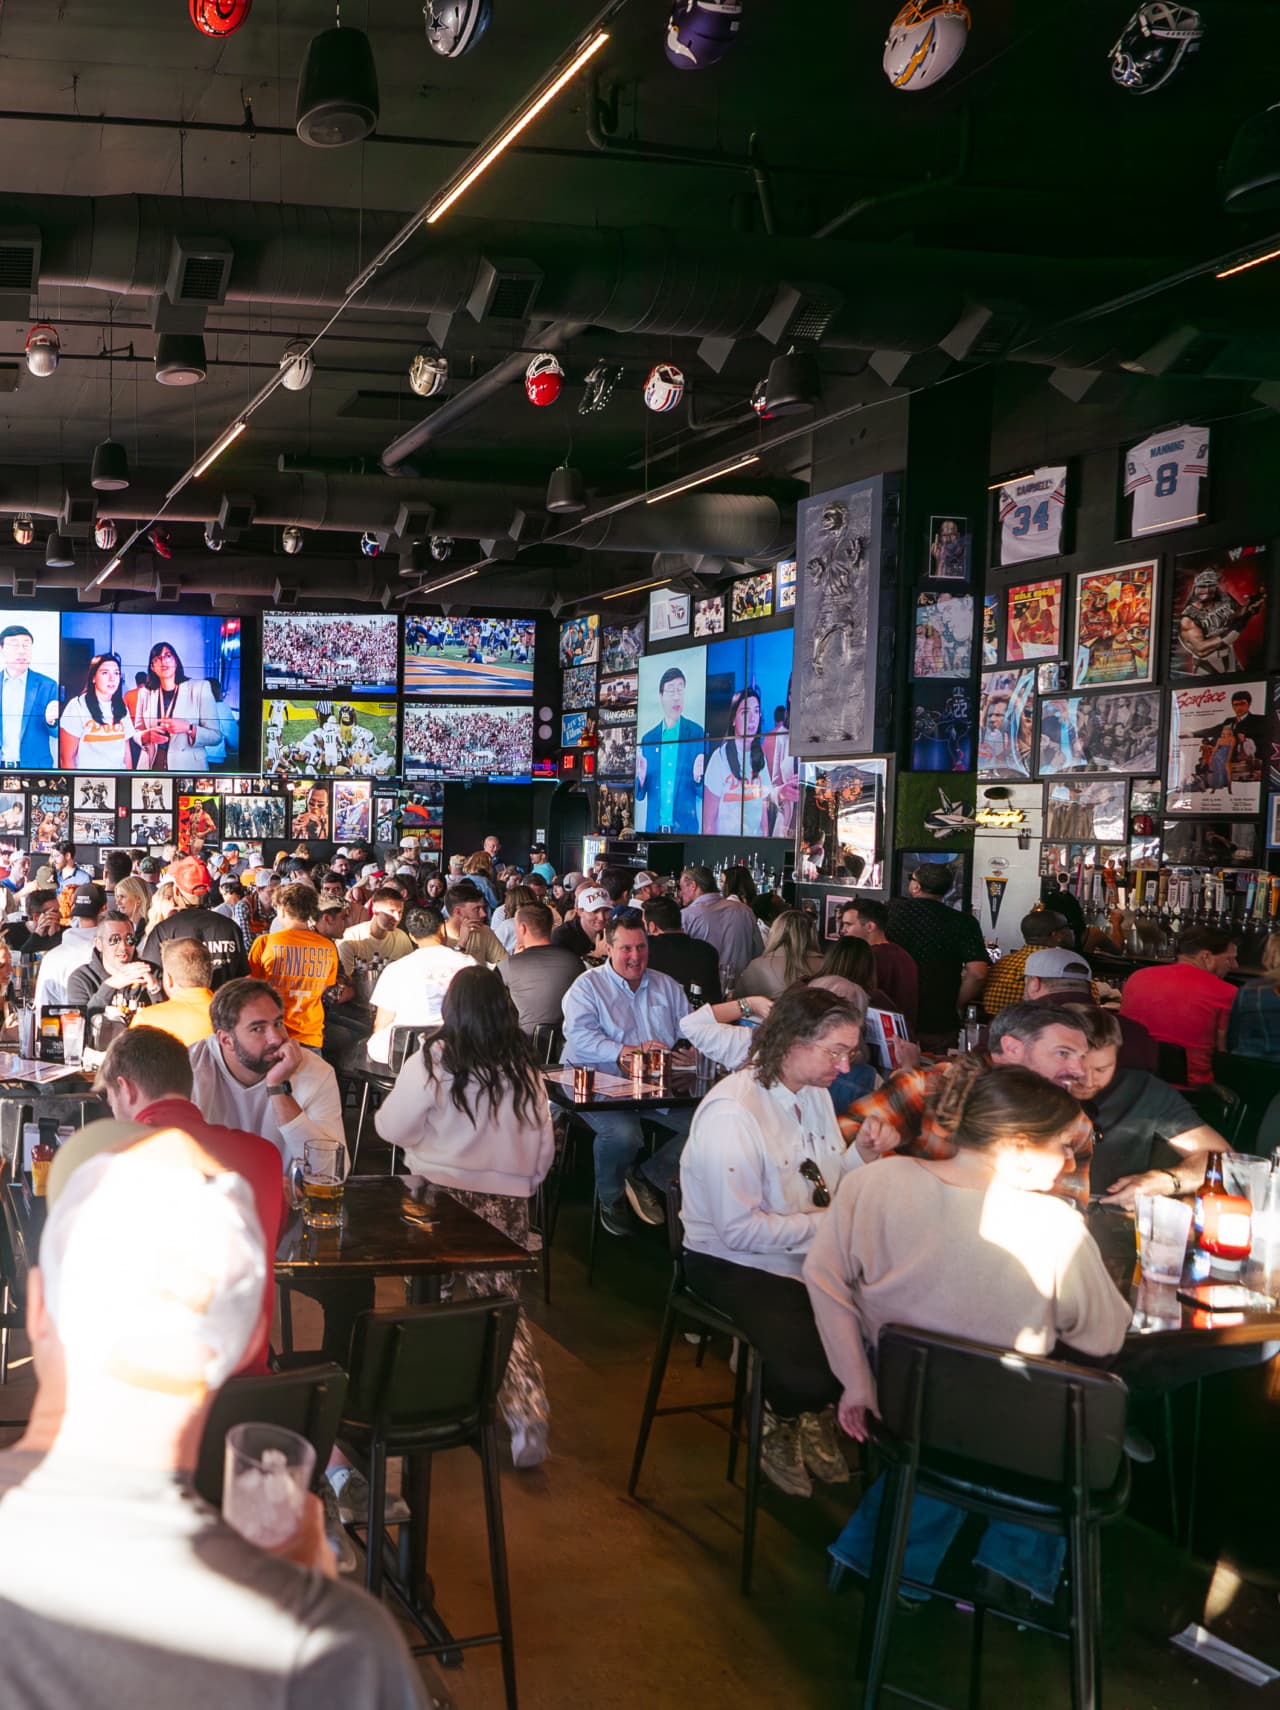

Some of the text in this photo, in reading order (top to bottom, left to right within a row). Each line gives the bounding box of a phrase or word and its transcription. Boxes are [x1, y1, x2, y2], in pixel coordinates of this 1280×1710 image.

[1154, 461, 1178, 498] 8
[1012, 501, 1050, 536] 34
[1176, 688, 1226, 709] Scarface
[202, 940, 236, 953] INTS
